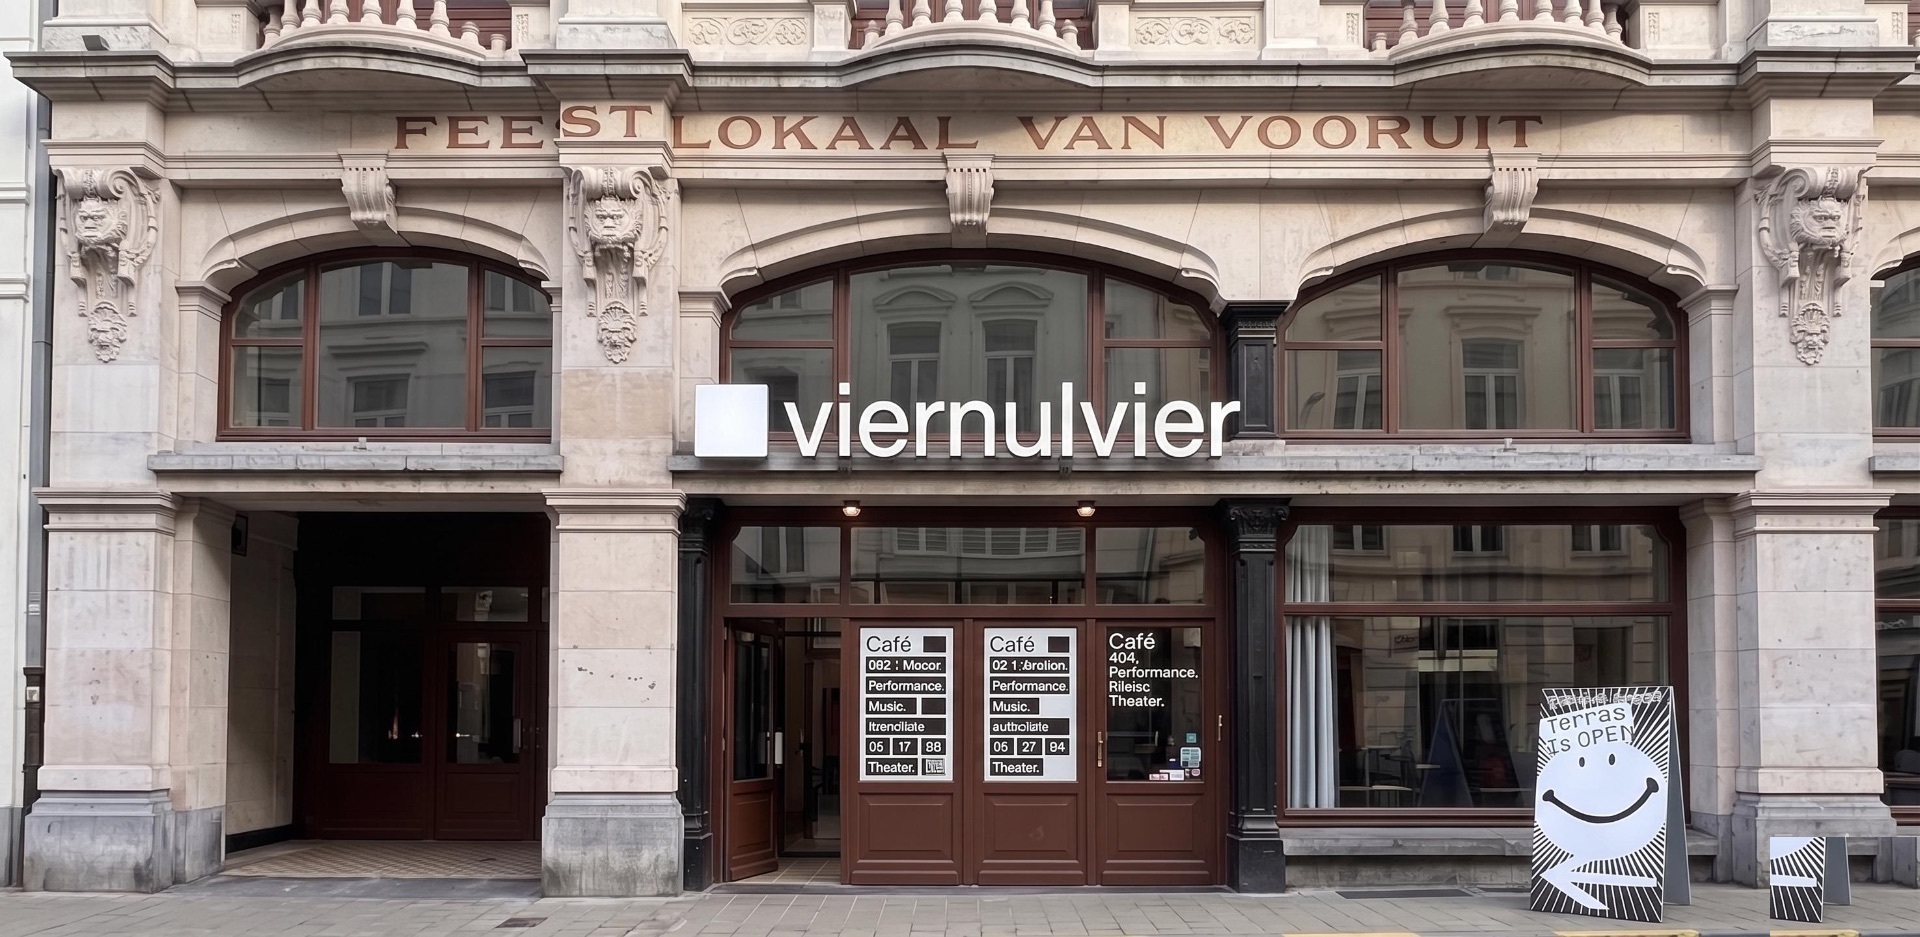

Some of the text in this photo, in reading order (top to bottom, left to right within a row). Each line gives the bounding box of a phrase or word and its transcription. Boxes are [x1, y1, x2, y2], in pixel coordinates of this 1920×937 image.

[1016, 115, 1167, 150] VAN
[1204, 115, 1544, 150] VOORUIT
[783, 381, 1241, 458] viernulvier
[866, 635, 912, 652] Café
[990, 635, 1035, 652] Café
[1108, 632, 1156, 650] Café
[1109, 666, 1199, 678] Performance.
[868, 680, 945, 692] Performance.
[992, 680, 1069, 692] Performance.
[868, 700, 906, 712] Music.
[992, 700, 1031, 712] Music.
[1108, 694, 1165, 707] Theater.
[1547, 707, 1626, 734] Terras
[1577, 725, 1635, 748] OPEN
[898, 741, 911, 752] 17
[1022, 741, 1037, 752] 27
[867, 761, 915, 773] Theater.
[992, 761, 1040, 773] Theater.
